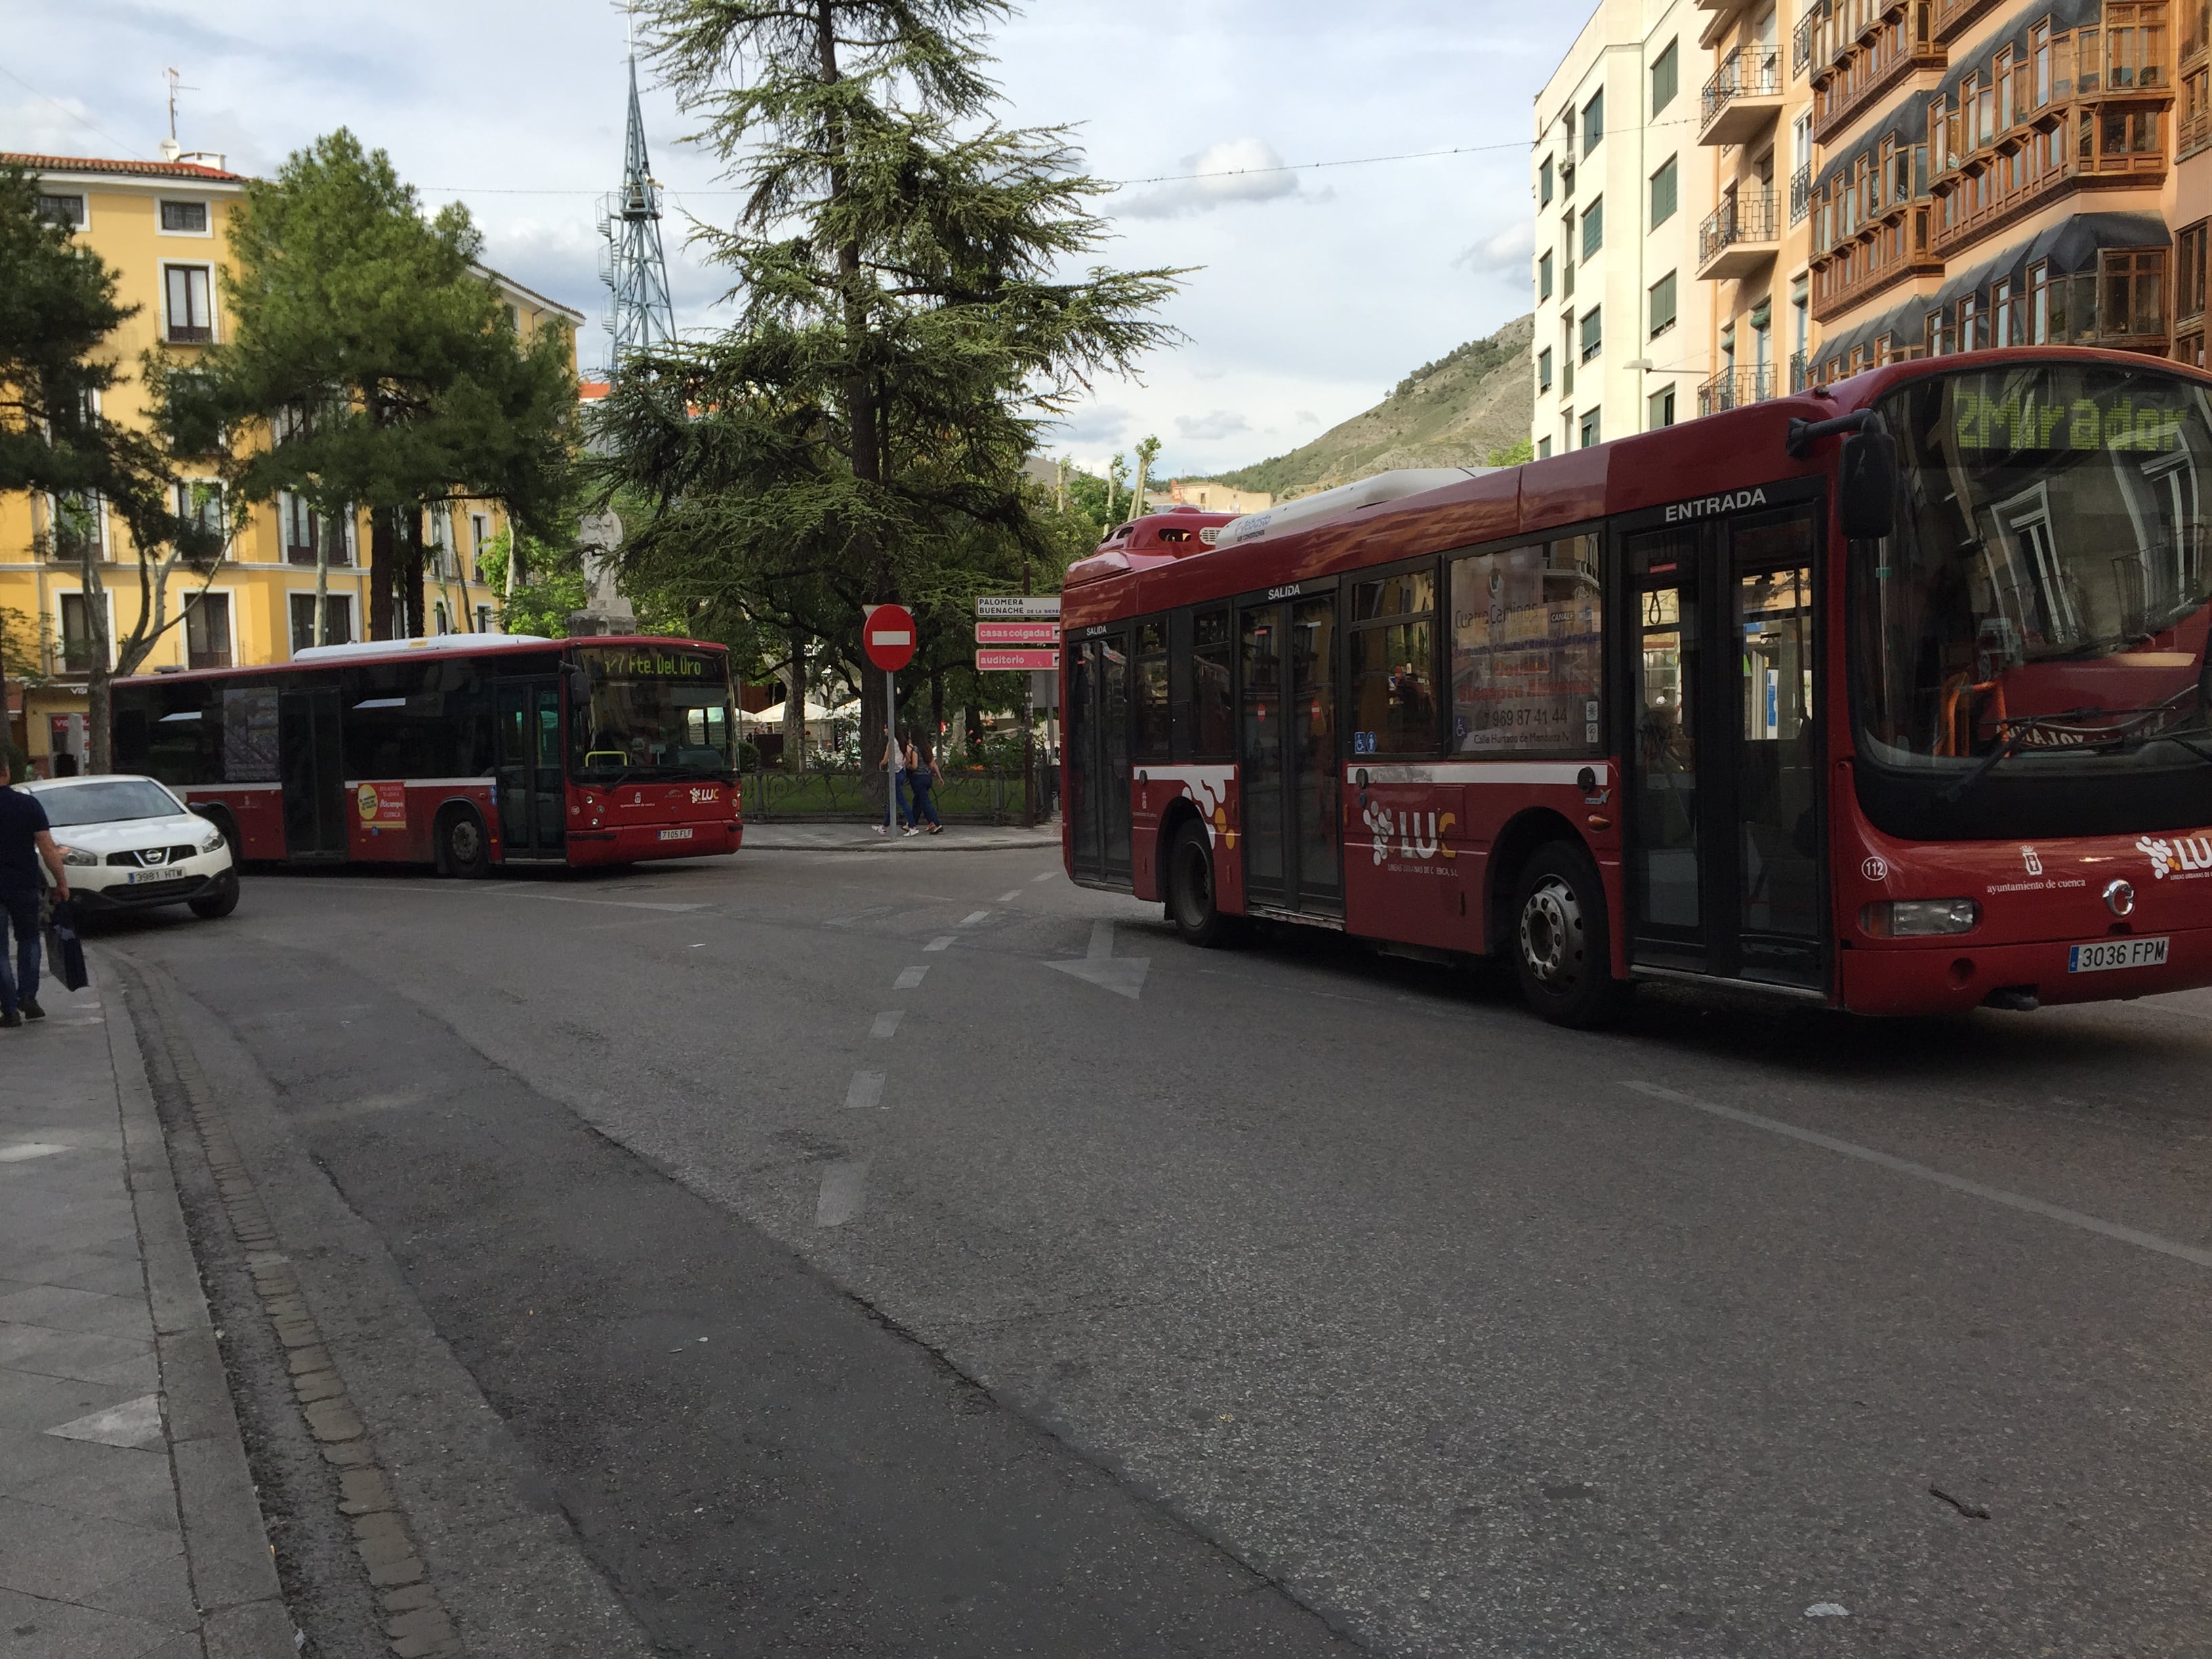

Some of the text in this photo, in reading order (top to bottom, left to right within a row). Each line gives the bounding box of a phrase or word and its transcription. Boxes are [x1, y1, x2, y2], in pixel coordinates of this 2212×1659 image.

[1666, 488, 1767, 522] ENTRADA
[1268, 583, 1300, 600] SALIDA
[1551, 611, 1574, 622] CANAL+
[1009, 628, 1050, 640] colgadas
[1086, 625, 1107, 636] SALIDA
[629, 655, 654, 674] Fte.
[657, 653, 678, 674] Del
[680, 655, 701, 675] Oro
[981, 655, 1025, 664] auditorio
[1492, 707, 1568, 726] 969 87 41 44
[1474, 734, 1490, 744] Calle
[1519, 733, 1528, 743] de
[701, 789, 719, 802] LUC
[662, 830, 678, 839] 7105
[1399, 811, 1456, 859] LUC
[2173, 837, 2212, 870] LU
[1866, 861, 1883, 876] 112
[1987, 879, 2087, 895] ayuntamiento de cuenca
[2082, 944, 2127, 968] 3036
[2132, 940, 2166, 964] FPM
